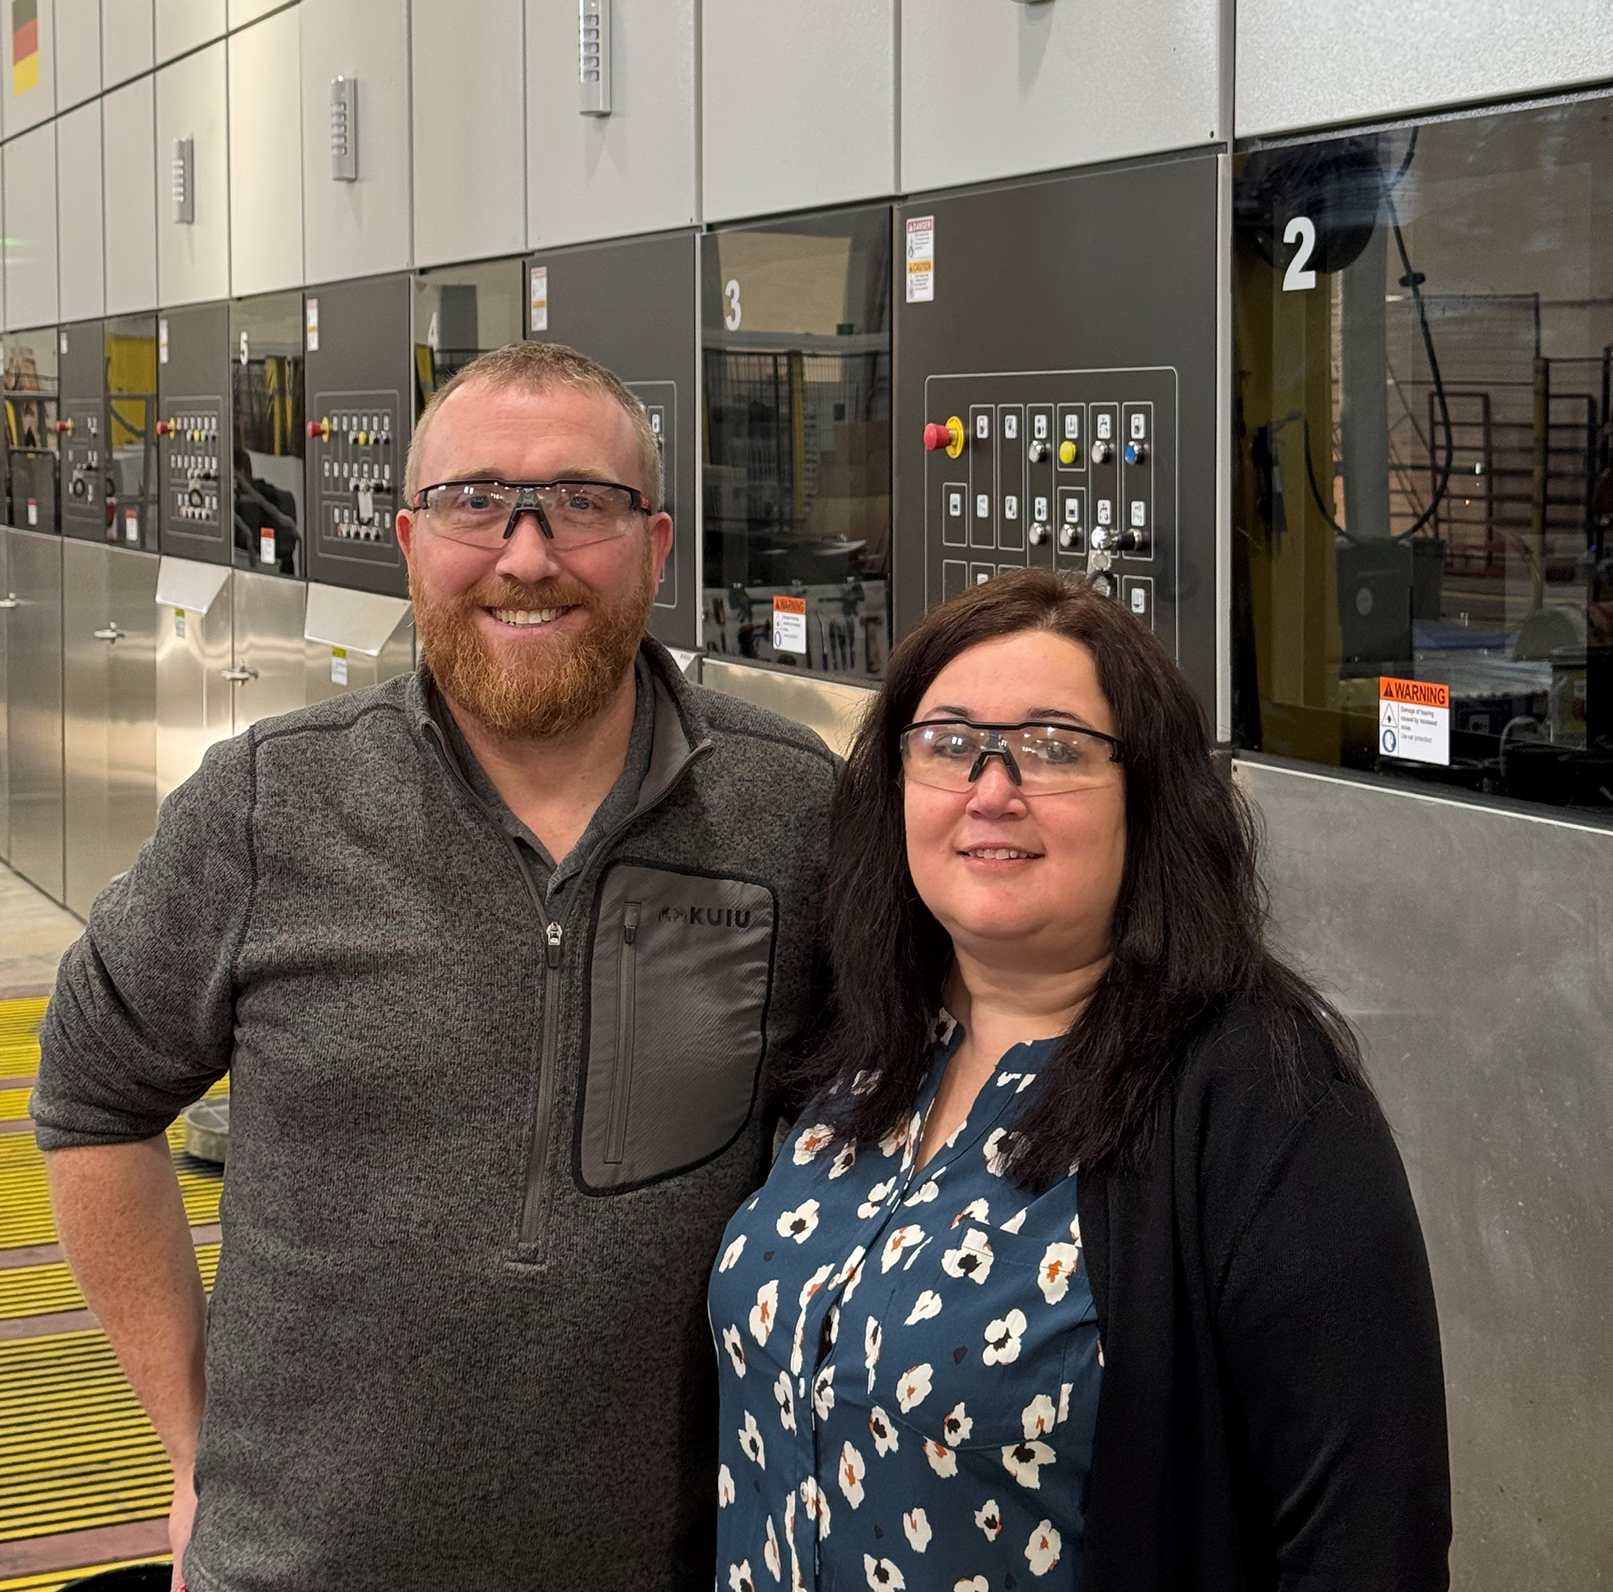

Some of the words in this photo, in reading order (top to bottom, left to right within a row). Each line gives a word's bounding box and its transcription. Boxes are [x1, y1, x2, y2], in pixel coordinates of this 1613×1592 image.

[912, 219, 932, 231] DANGER
[1282, 216, 1316, 292] 2
[913, 261, 932, 272] CAUTION
[725, 279, 742, 332] 3
[427, 312, 439, 352] 4
[240, 331, 249, 365] 5
[780, 599, 804, 612] WARNING
[1394, 682, 1446, 705] WARNING
[690, 906, 751, 929] KUIU
